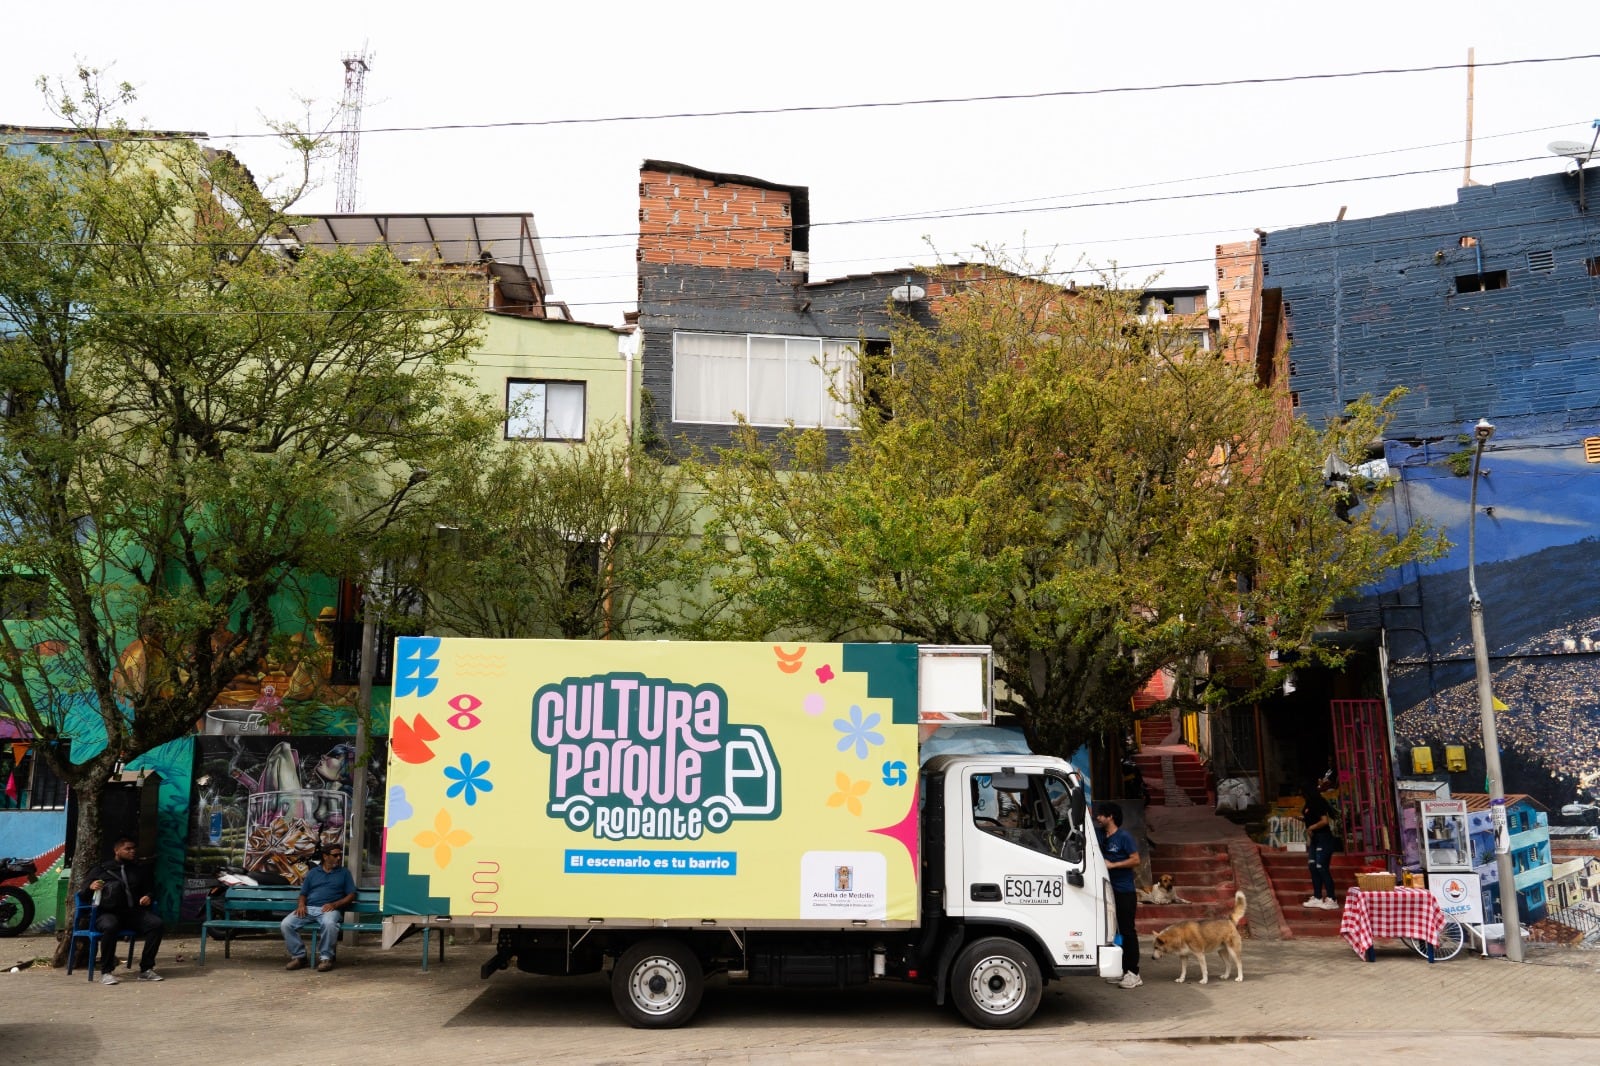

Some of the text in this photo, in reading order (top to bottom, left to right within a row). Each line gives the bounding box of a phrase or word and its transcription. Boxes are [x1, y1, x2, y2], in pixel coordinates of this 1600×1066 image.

[570, 855, 730, 869] El escenario es tu barrio
